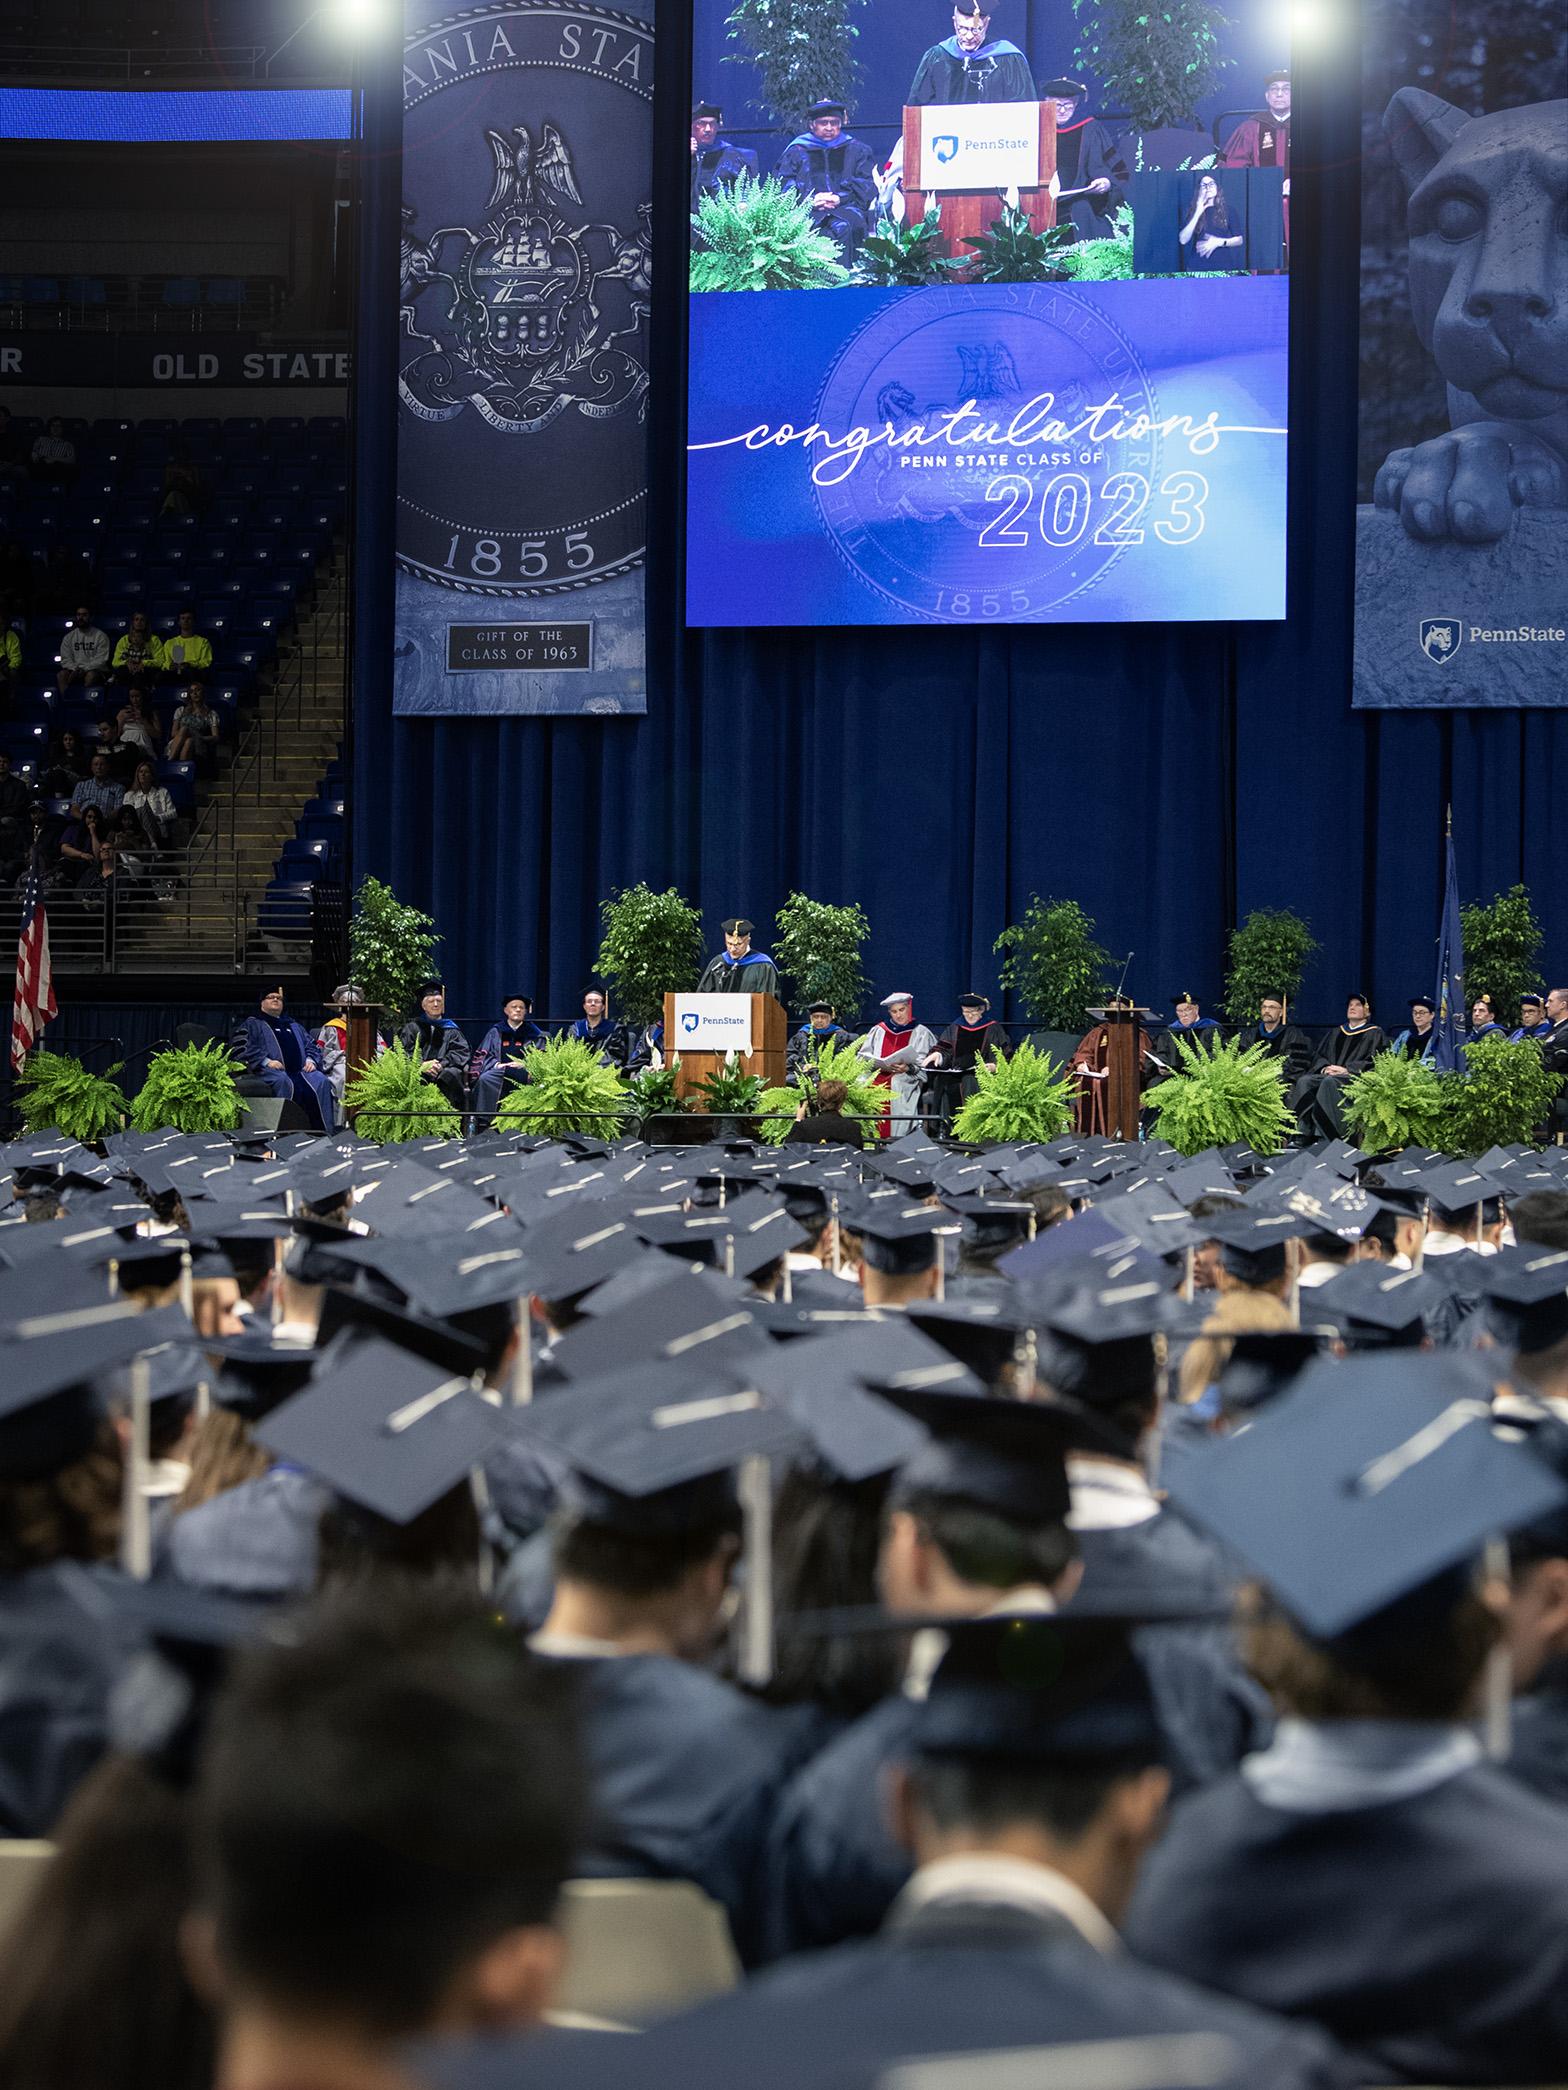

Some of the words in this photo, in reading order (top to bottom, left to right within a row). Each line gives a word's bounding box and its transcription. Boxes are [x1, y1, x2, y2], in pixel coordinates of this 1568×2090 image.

[559, 24, 655, 91] STA
[964, 138, 1029, 151] PennState
[1005, 283, 1098, 340] STATE
[152, 353, 219, 379] OLD
[242, 353, 351, 379] STATE
[404, 391, 446, 421] VIRTUE
[479, 402, 533, 432] LIBERTY
[742, 392, 1221, 486] congratulations
[900, 455, 948, 468] PENN
[955, 453, 1009, 467] STATE
[1016, 452, 1072, 466] CLASS
[1079, 452, 1102, 465] OF
[979, 470, 1209, 548] 2023
[443, 531, 595, 577] 1855
[933, 589, 1030, 617] 1855
[476, 631, 506, 642] GIFT
[513, 631, 529, 642] OF
[539, 630, 563, 641] THE
[1469, 626, 1566, 643] PennState
[461, 648, 507, 660] CLASS
[515, 648, 534, 660] OF
[543, 646, 578, 661] 1963
[702, 1016, 745, 1025] PennState
